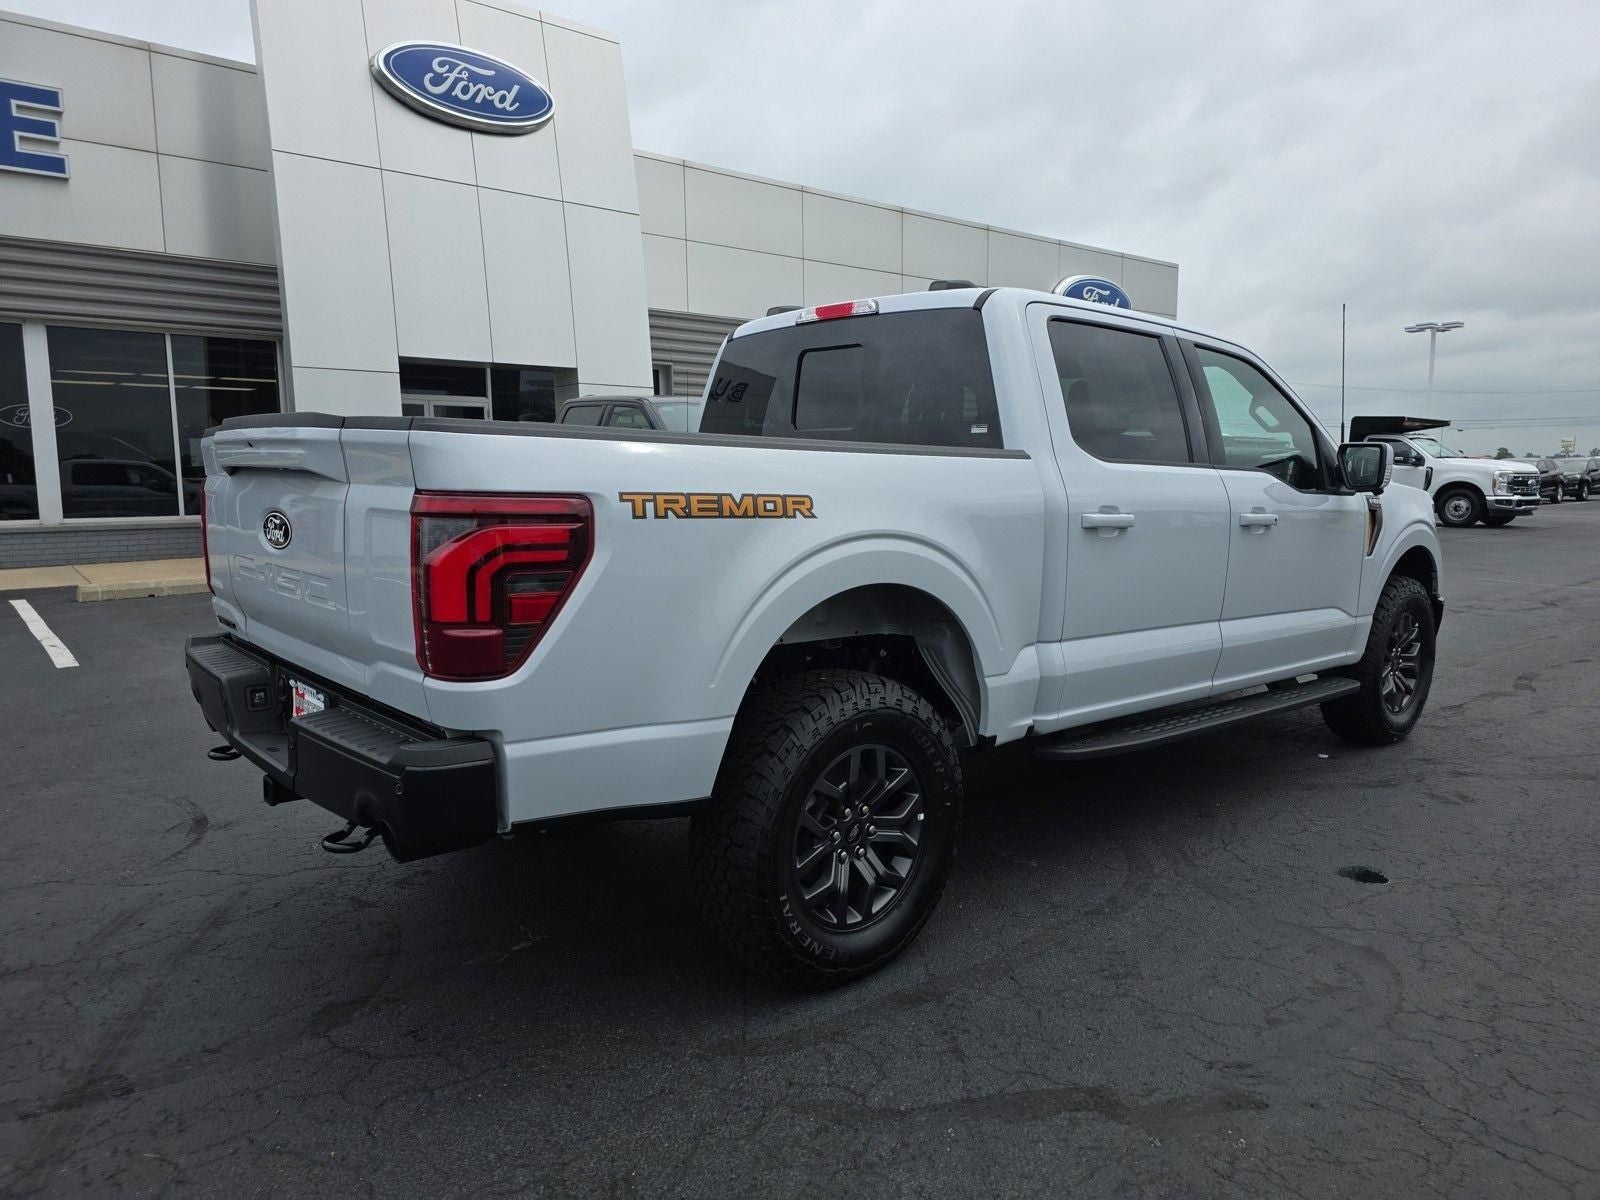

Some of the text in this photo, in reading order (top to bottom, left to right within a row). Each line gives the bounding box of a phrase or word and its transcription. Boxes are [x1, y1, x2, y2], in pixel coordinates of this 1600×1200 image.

[423, 56, 520, 112] Ford
[0, 78, 69, 179] E
[618, 492, 818, 519] TREMOR
